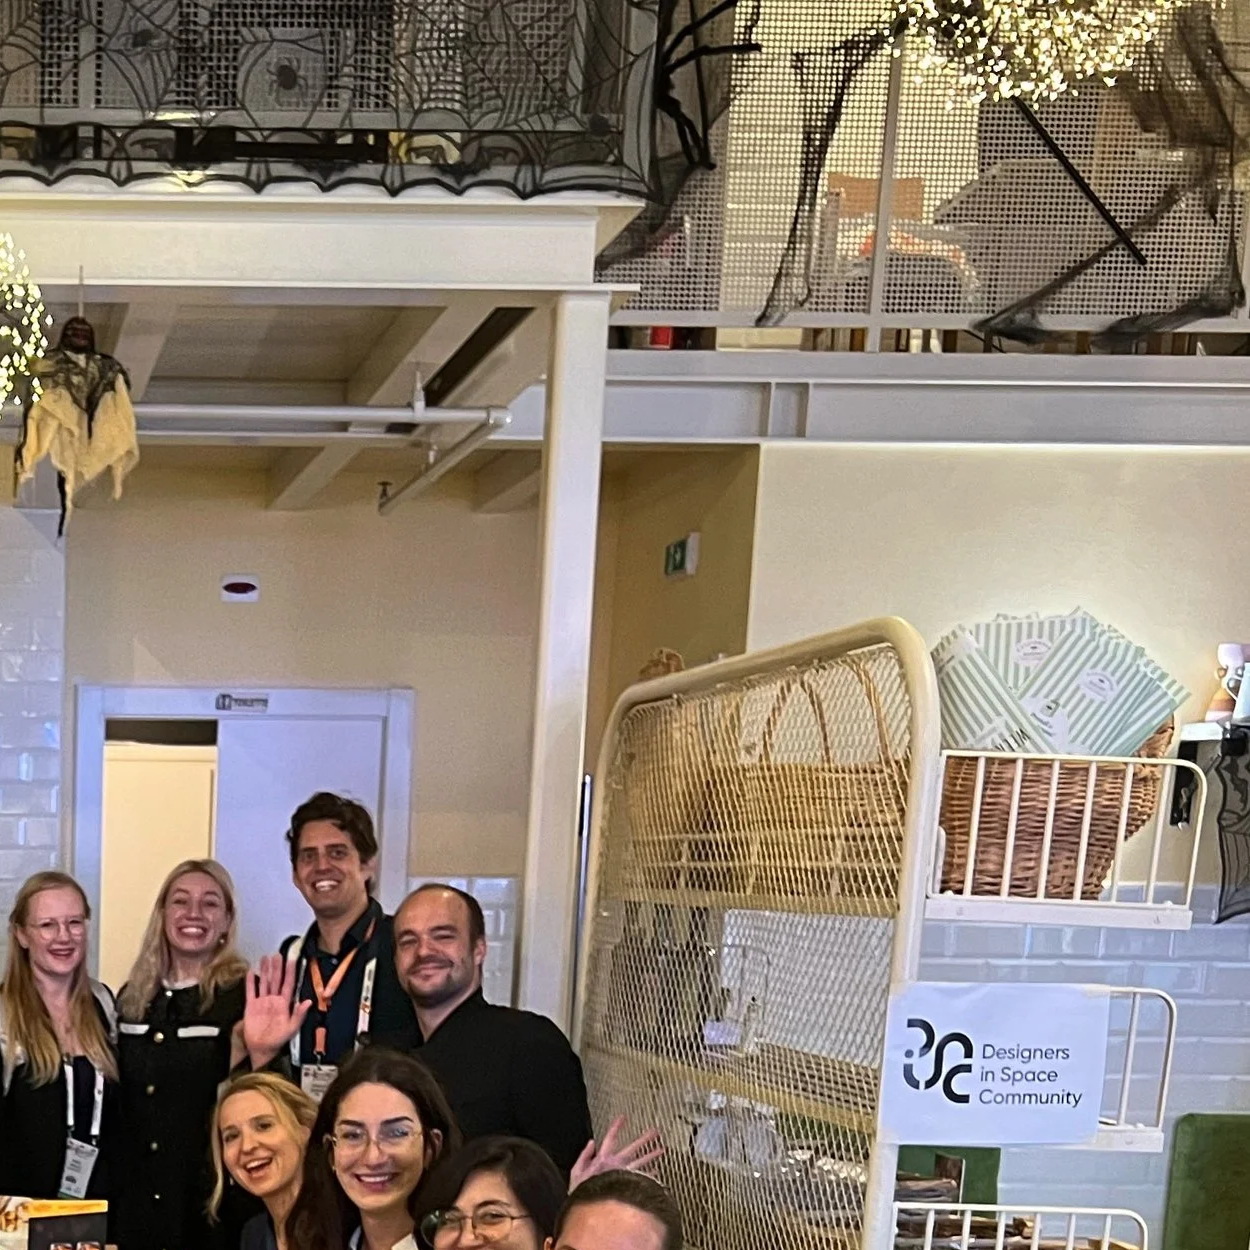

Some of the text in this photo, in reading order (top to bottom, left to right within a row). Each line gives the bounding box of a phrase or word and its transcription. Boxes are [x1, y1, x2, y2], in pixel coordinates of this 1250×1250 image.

[982, 1044, 1070, 1064] Designers
[980, 1066, 1059, 1085] in Space
[979, 1089, 1083, 1108] Community
